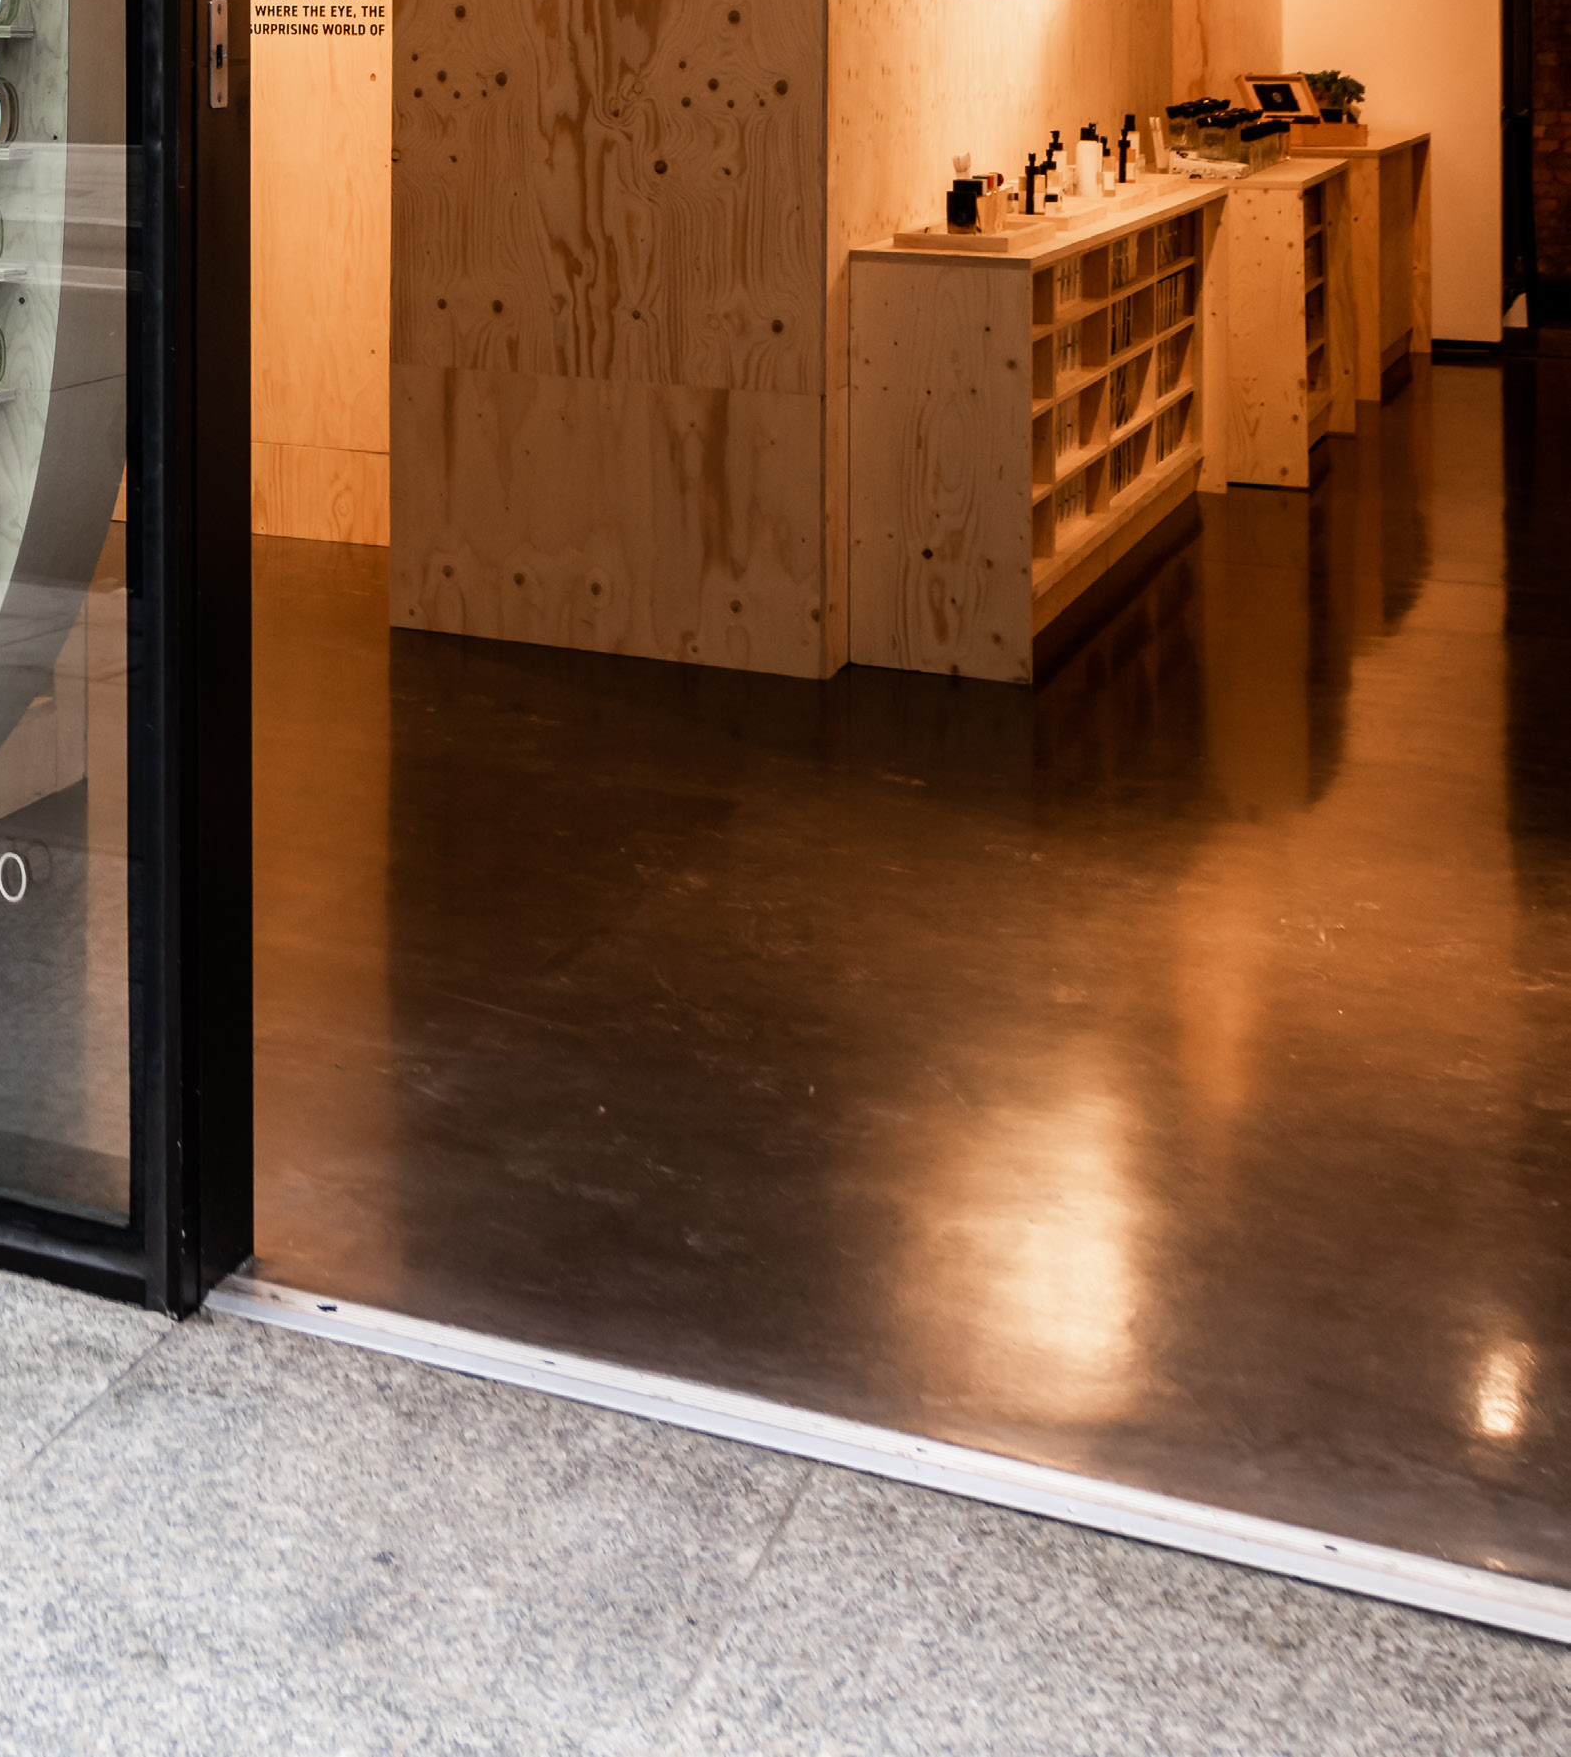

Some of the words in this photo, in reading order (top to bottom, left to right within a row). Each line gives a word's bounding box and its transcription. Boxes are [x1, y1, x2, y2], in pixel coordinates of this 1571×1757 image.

[255, 5, 298, 17] WHERE
[303, 5, 326, 17] THE
[330, 5, 356, 19] EYE,
[361, 5, 385, 17] THE
[322, 23, 366, 35] WORLD
[369, 23, 385, 35] OF
